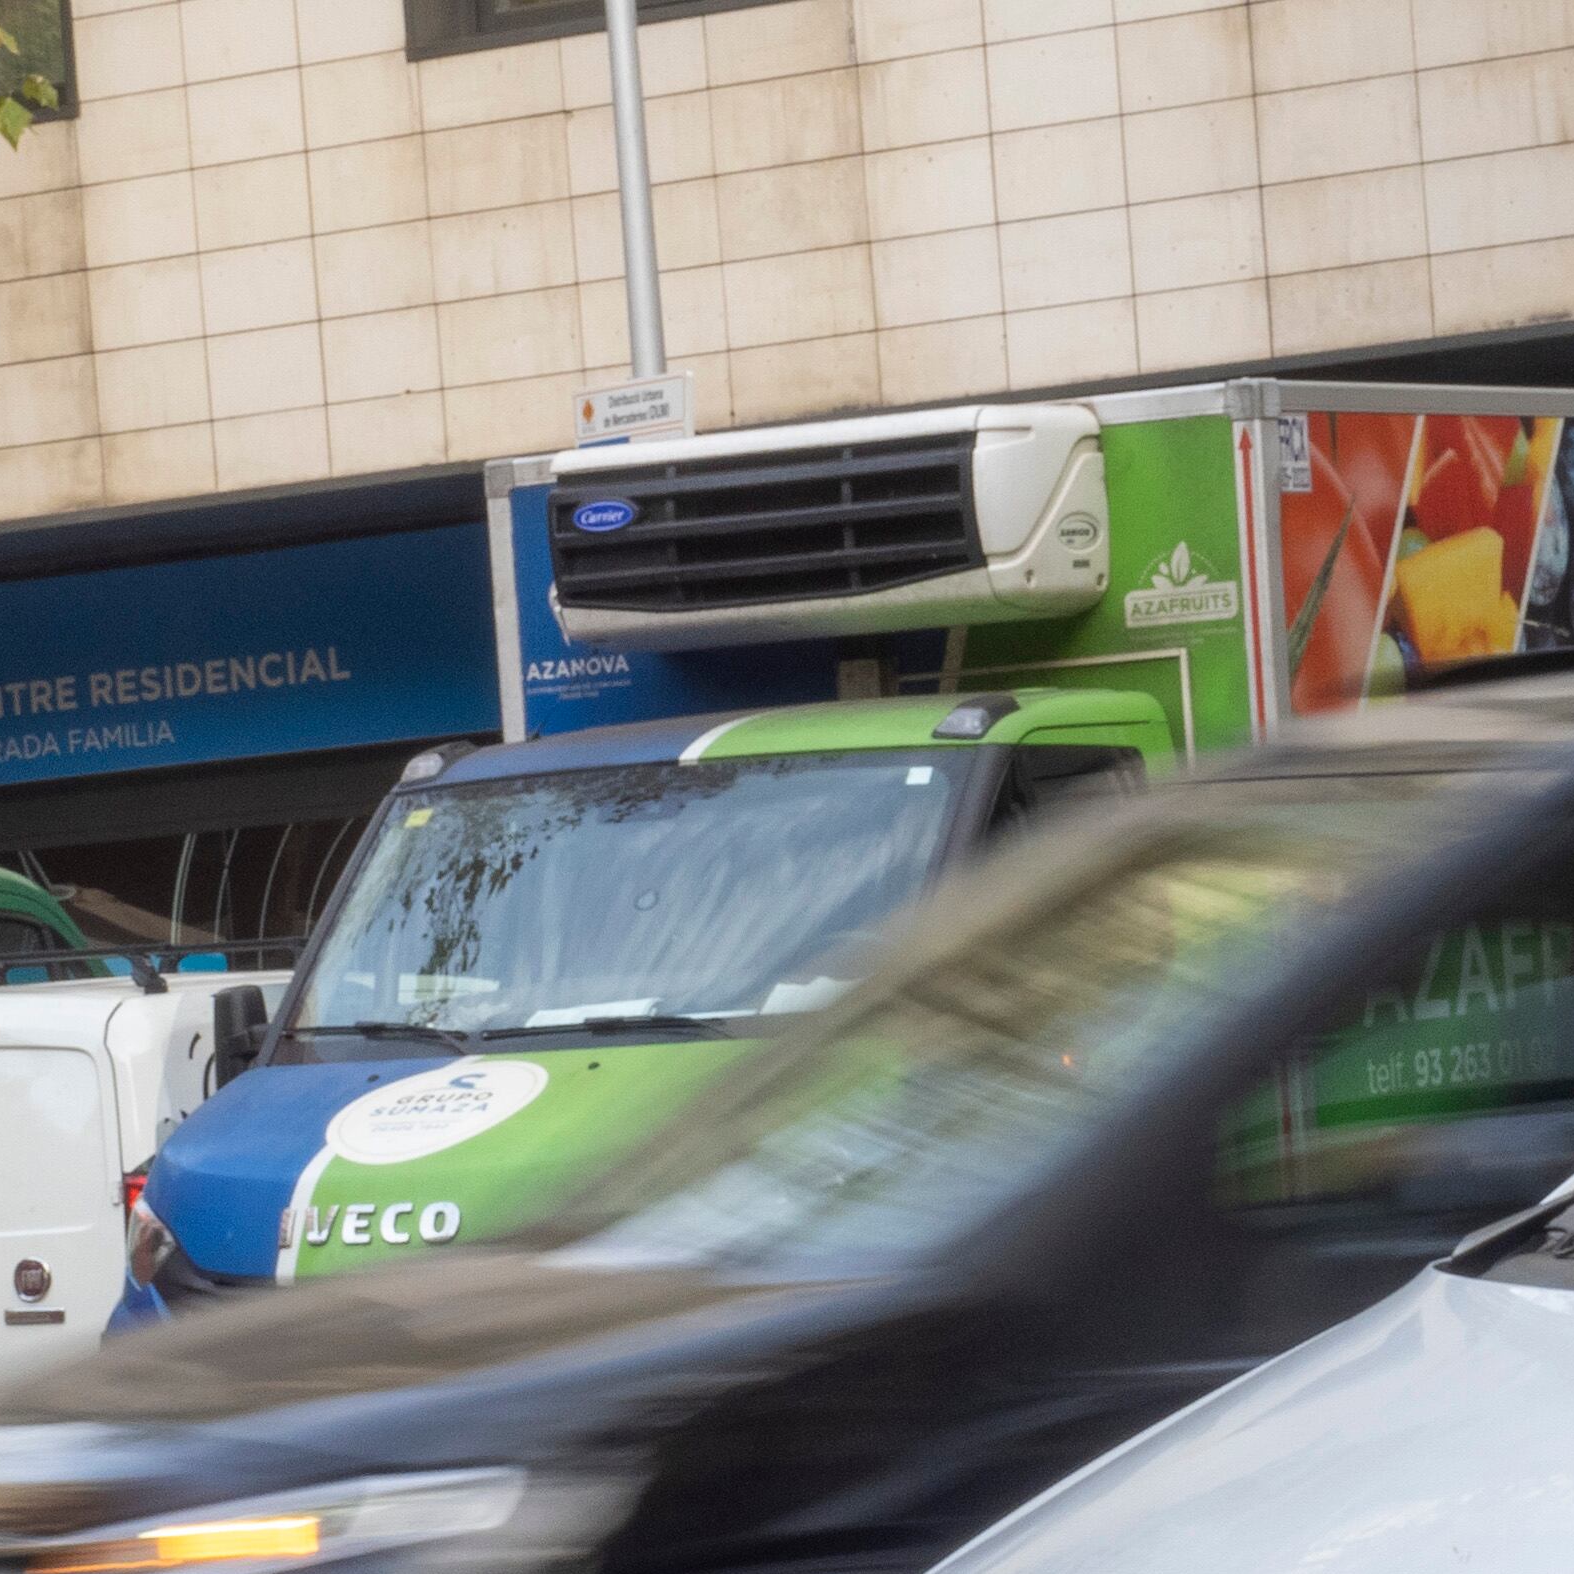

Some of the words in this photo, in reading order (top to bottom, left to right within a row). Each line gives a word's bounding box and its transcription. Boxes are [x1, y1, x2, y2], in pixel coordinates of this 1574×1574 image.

[579, 509, 626, 525] Carrier
[1130, 591, 1232, 617] AZAFRUITS
[89, 646, 352, 708] RESIDENCIAL
[526, 653, 630, 681] AZANOVA
[68, 719, 176, 754] FAMILIA
[1413, 1047, 1444, 1088] 93
[1449, 1042, 1491, 1083] 263
[370, 1102, 489, 1117] SUMAZA
[396, 1091, 493, 1105] GRUPO
[278, 1201, 461, 1249] IVECO
